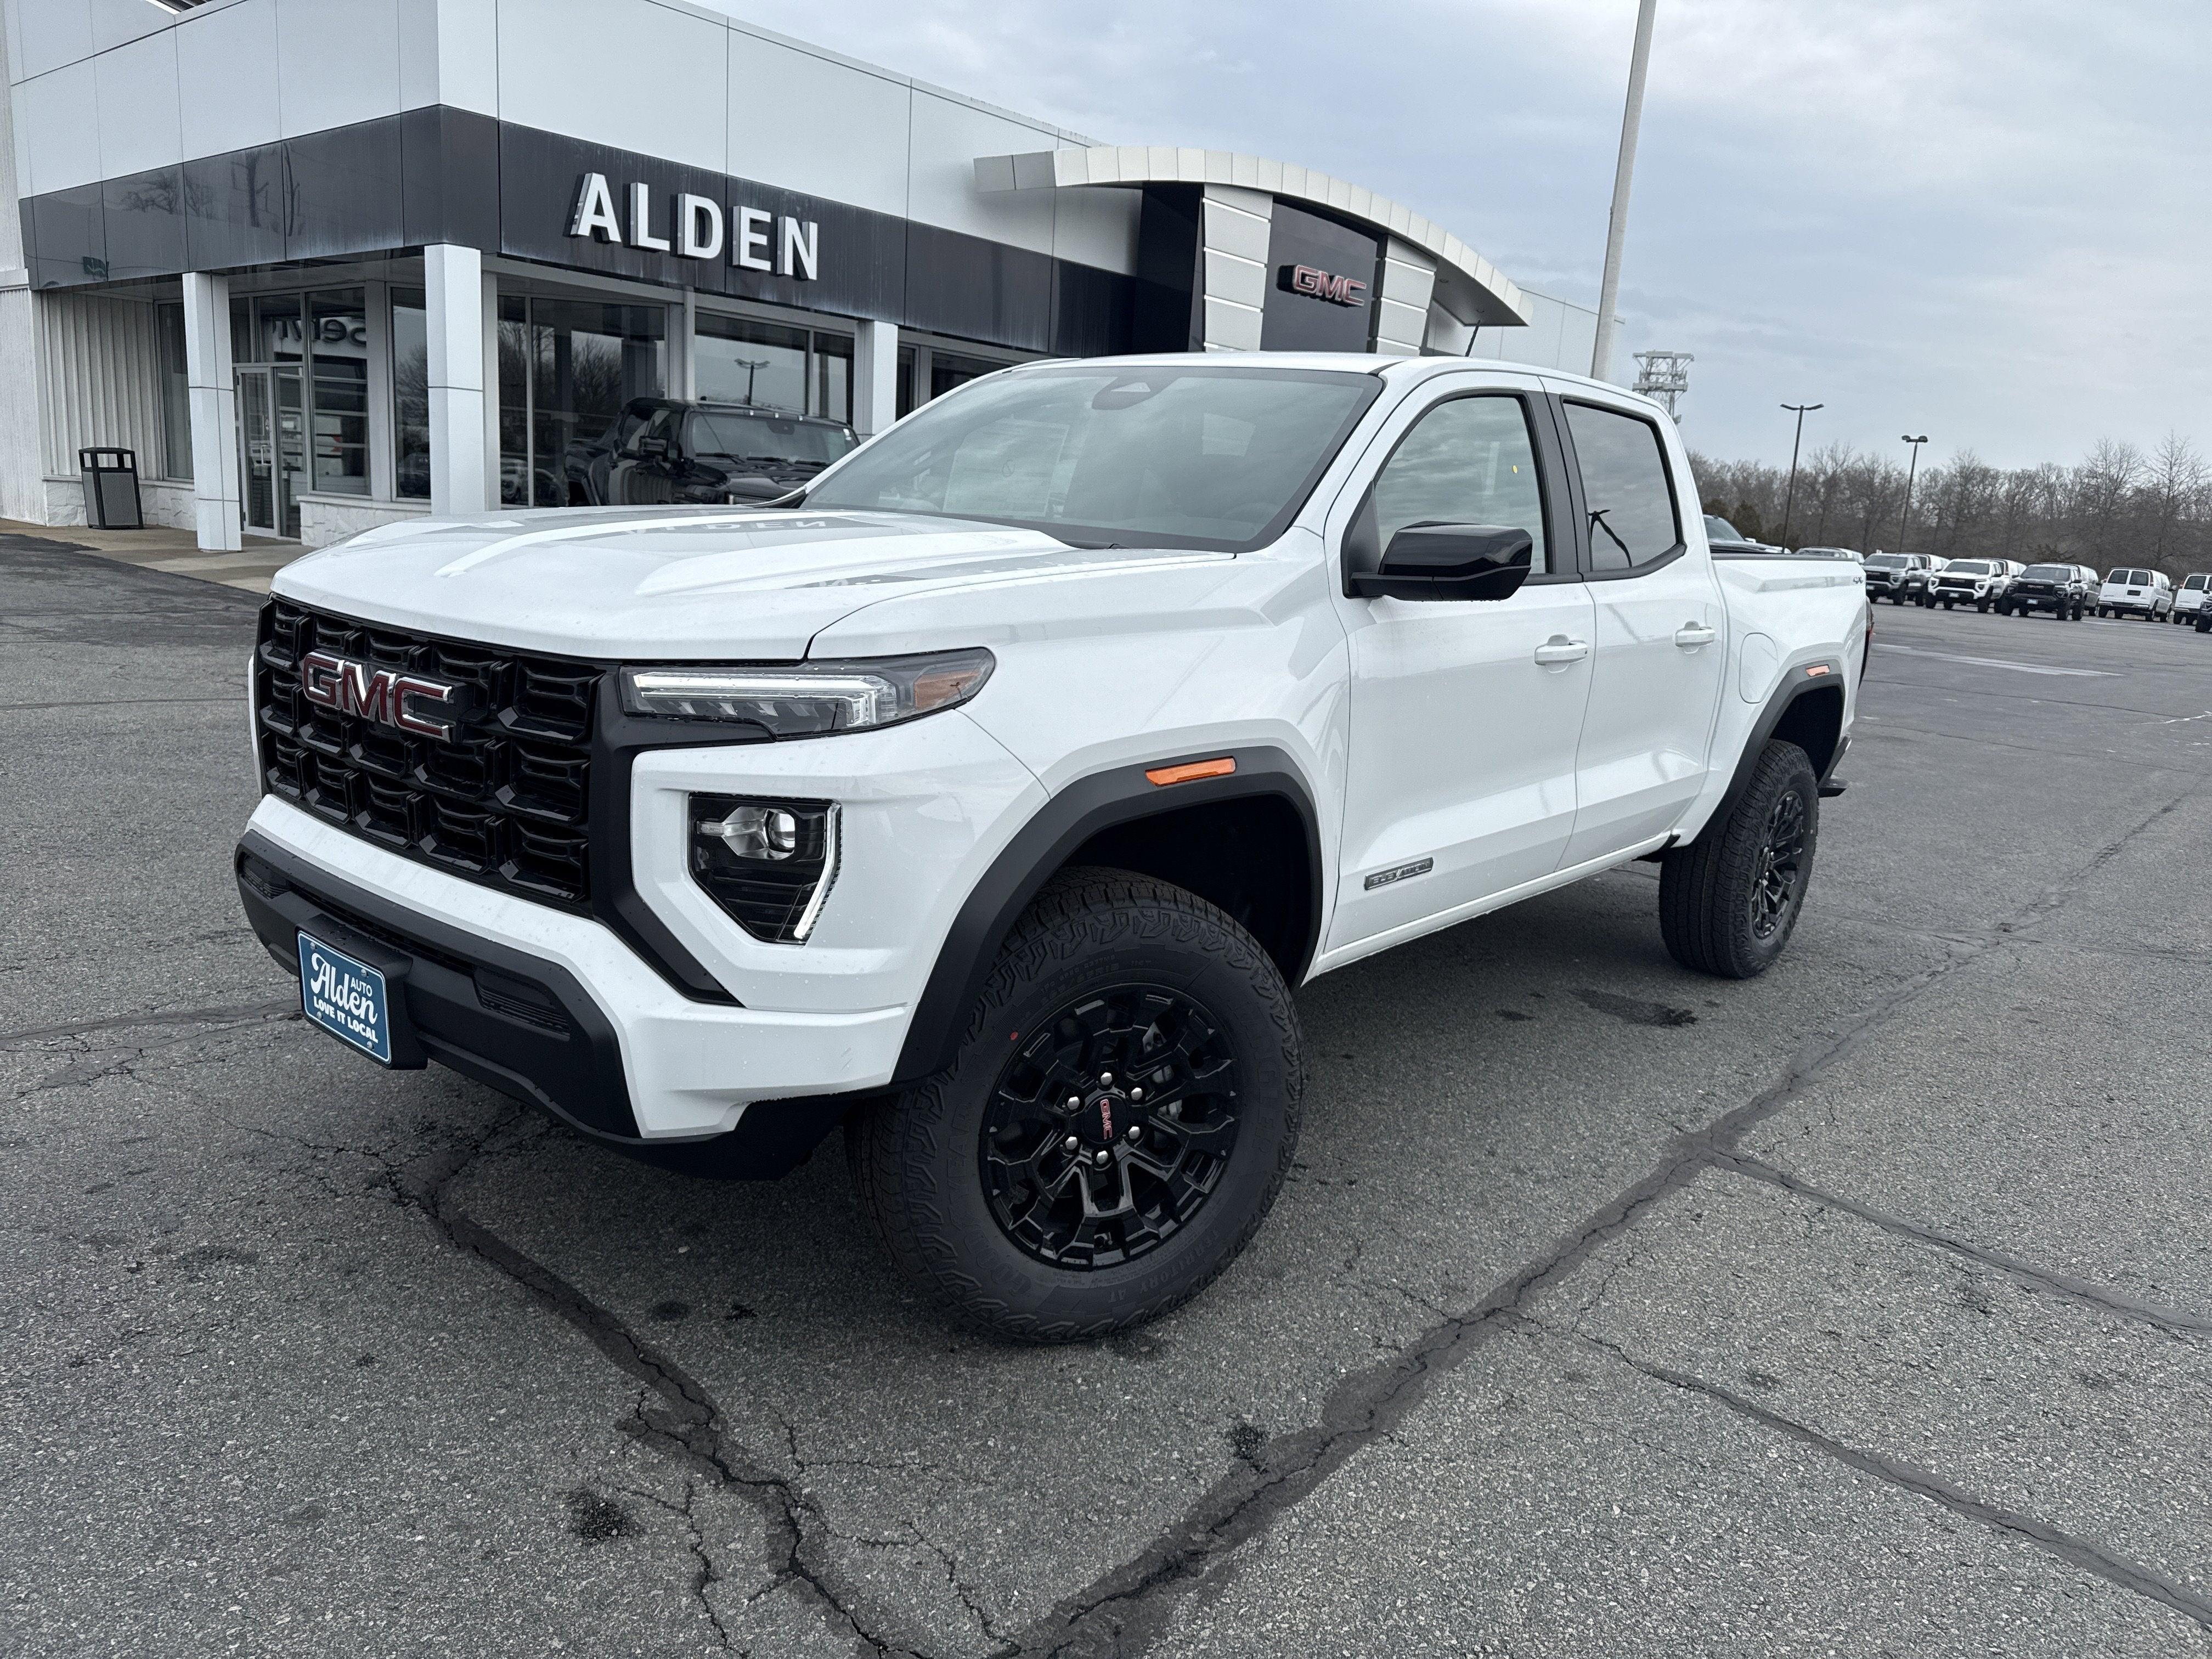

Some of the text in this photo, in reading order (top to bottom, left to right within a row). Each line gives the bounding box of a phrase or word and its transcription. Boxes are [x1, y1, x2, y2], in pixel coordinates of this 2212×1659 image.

[569, 172, 819, 281] ALDEN
[1294, 264, 1367, 307] GMC
[303, 651, 453, 743] GMC
[310, 952, 378, 1024] Alden
[350, 977, 373, 997] AUTO
[313, 995, 379, 1043] LOVE IT LOCAL
[1099, 1098, 1113, 1140] GMC
